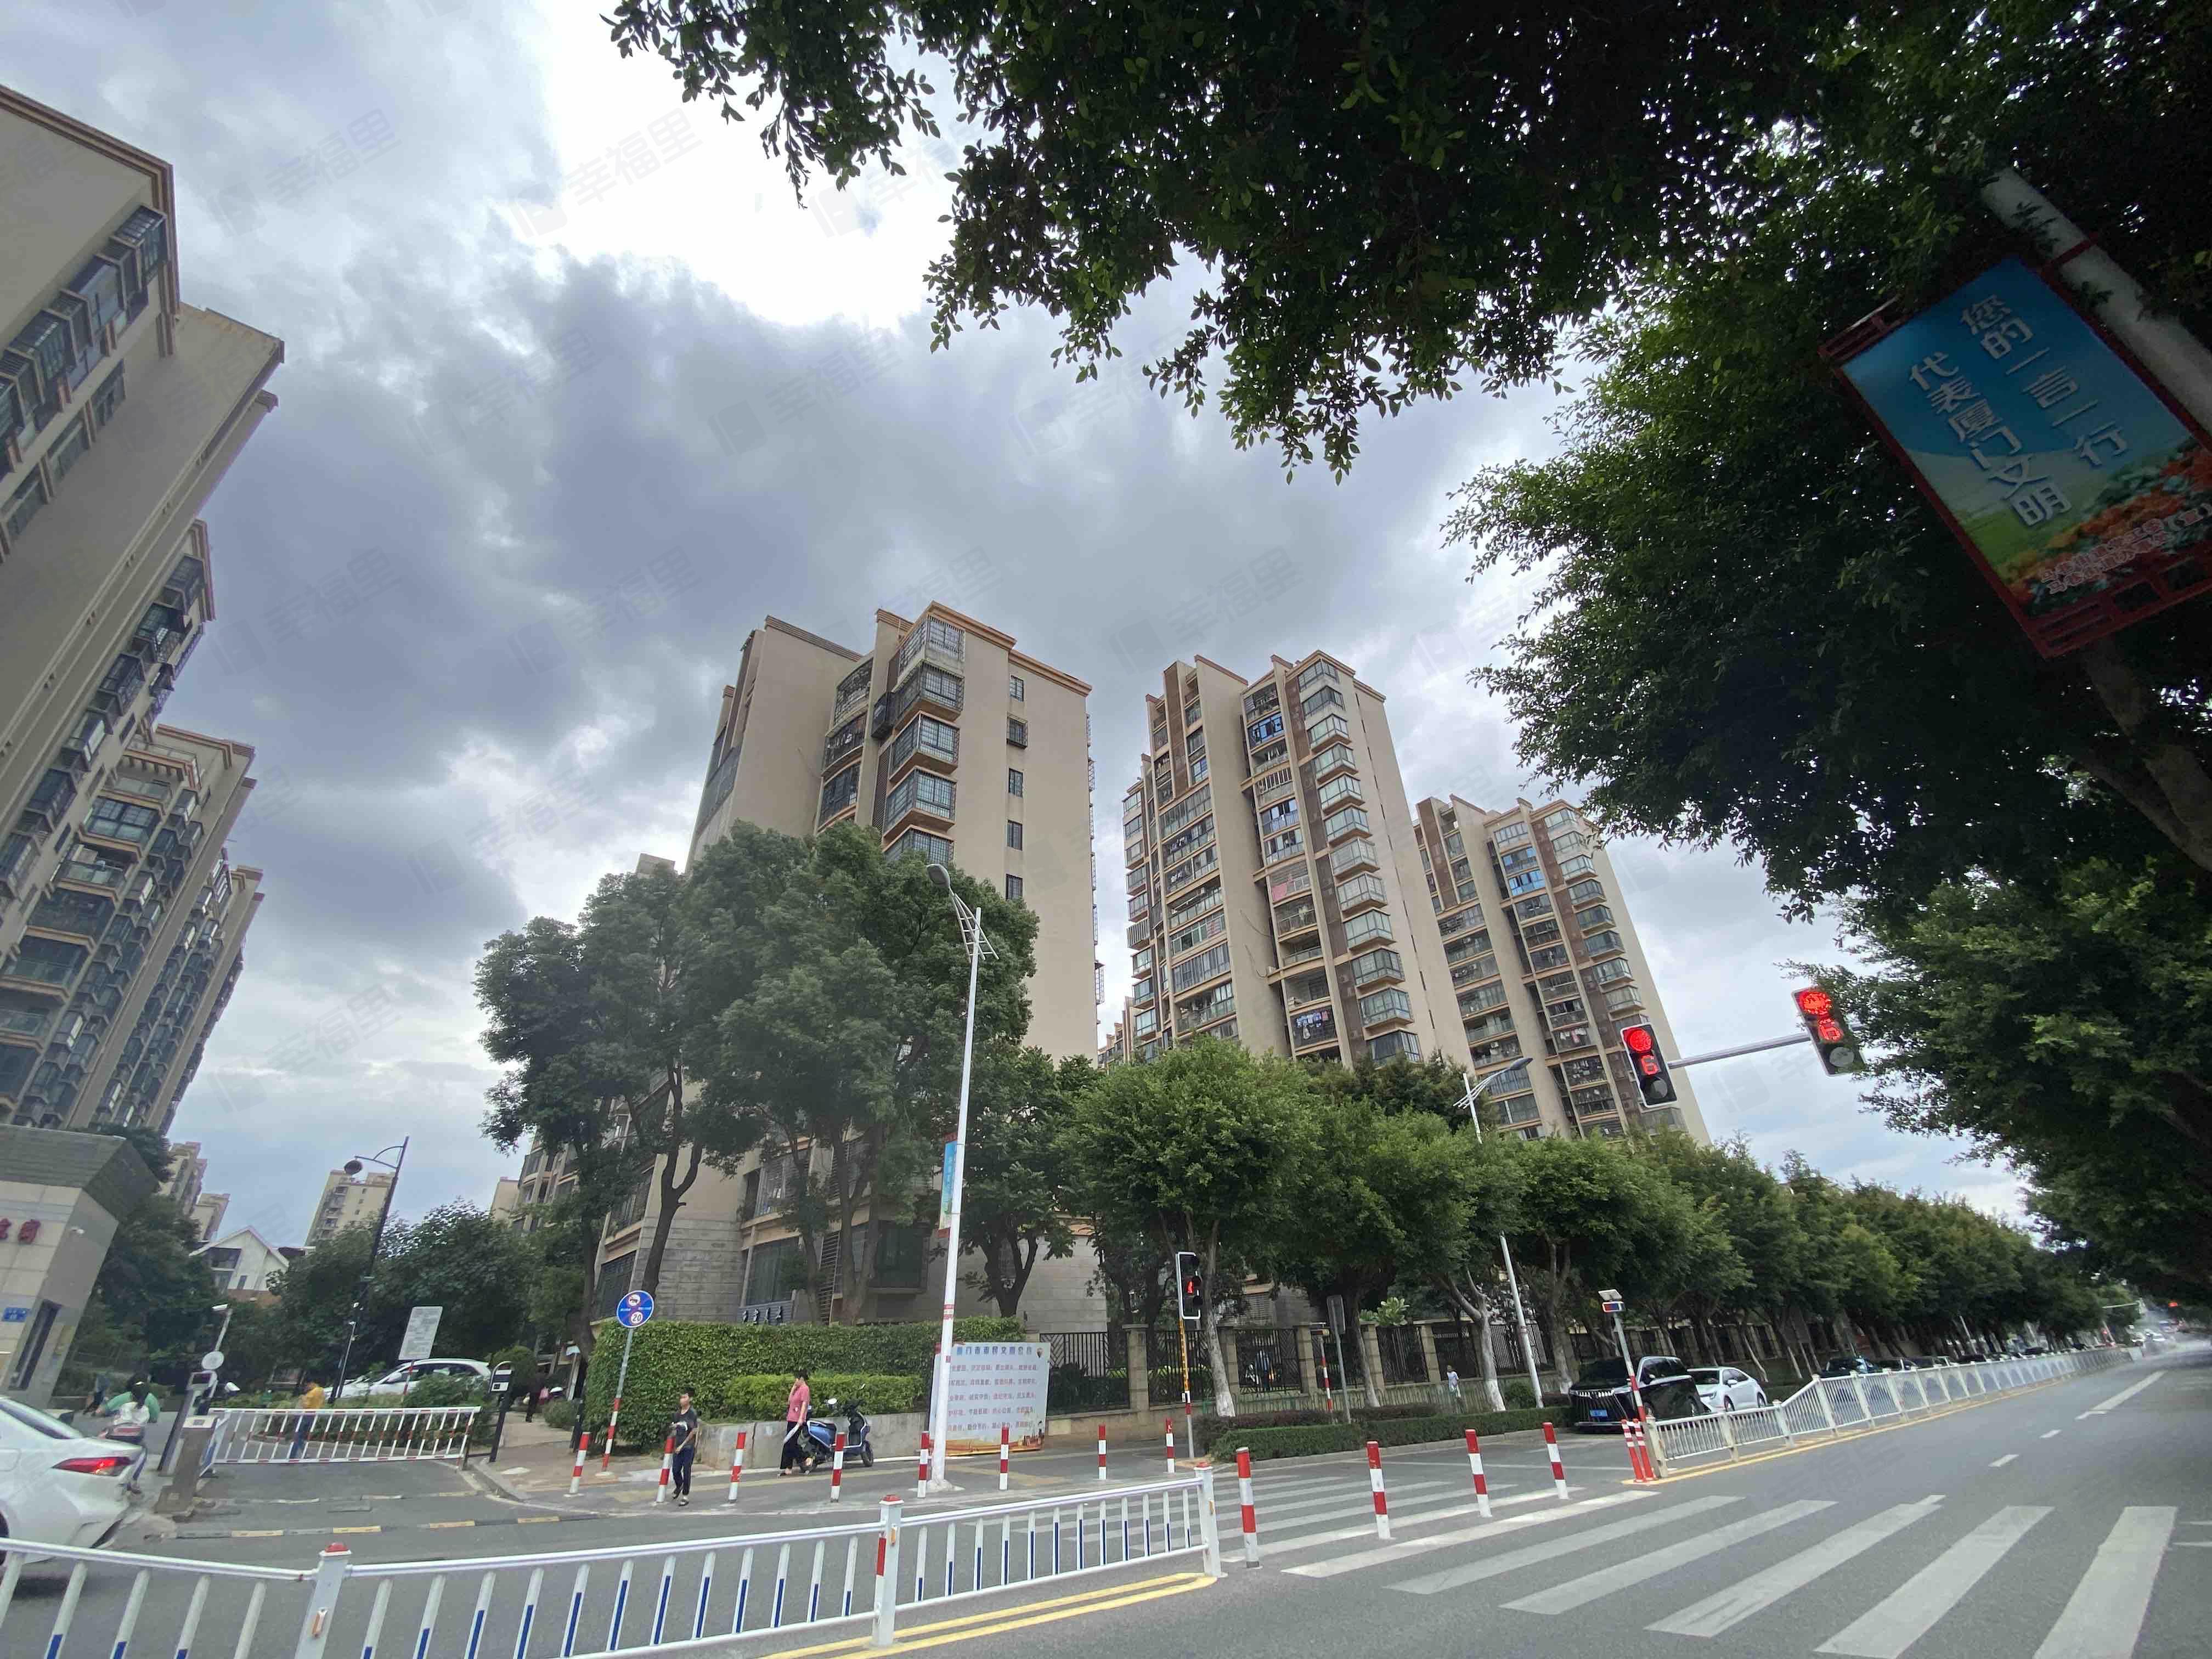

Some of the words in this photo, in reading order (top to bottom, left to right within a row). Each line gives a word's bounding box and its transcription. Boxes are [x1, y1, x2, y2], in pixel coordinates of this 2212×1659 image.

[1909, 351, 2072, 526] 代表厦门文明
[1960, 294, 2128, 467] 您的一言一行
[1641, 1054, 1659, 1075] 6
